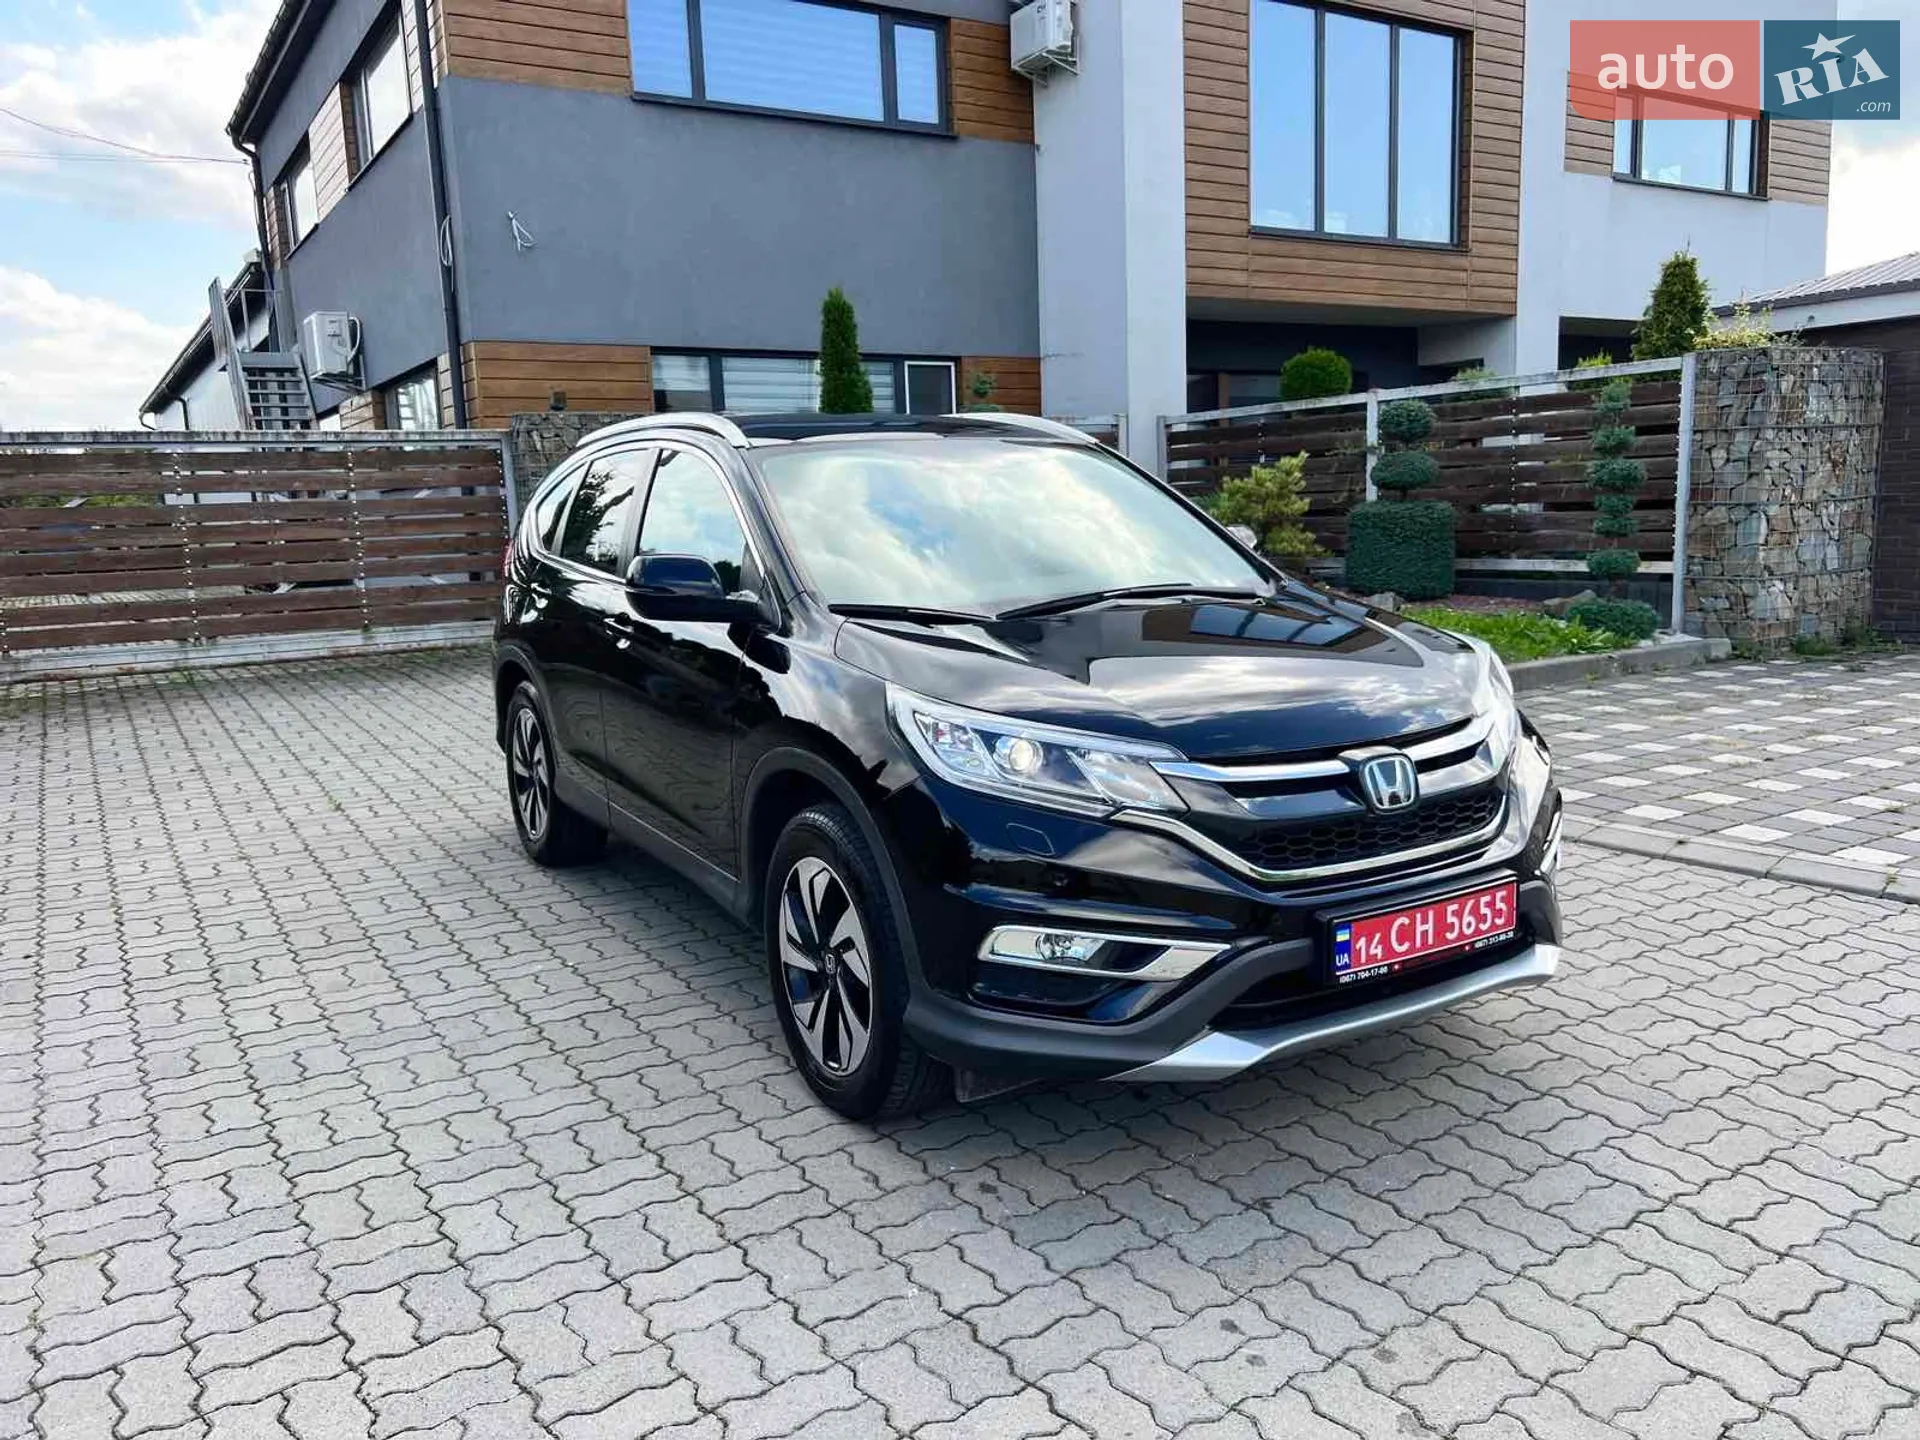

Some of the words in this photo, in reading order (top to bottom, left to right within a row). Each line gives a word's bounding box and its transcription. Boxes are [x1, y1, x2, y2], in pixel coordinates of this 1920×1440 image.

[1355, 934, 1383, 964] 14
[1390, 910, 1434, 953] CH
[1445, 890, 1507, 940] 5655
[1335, 954, 1350, 966] UA
